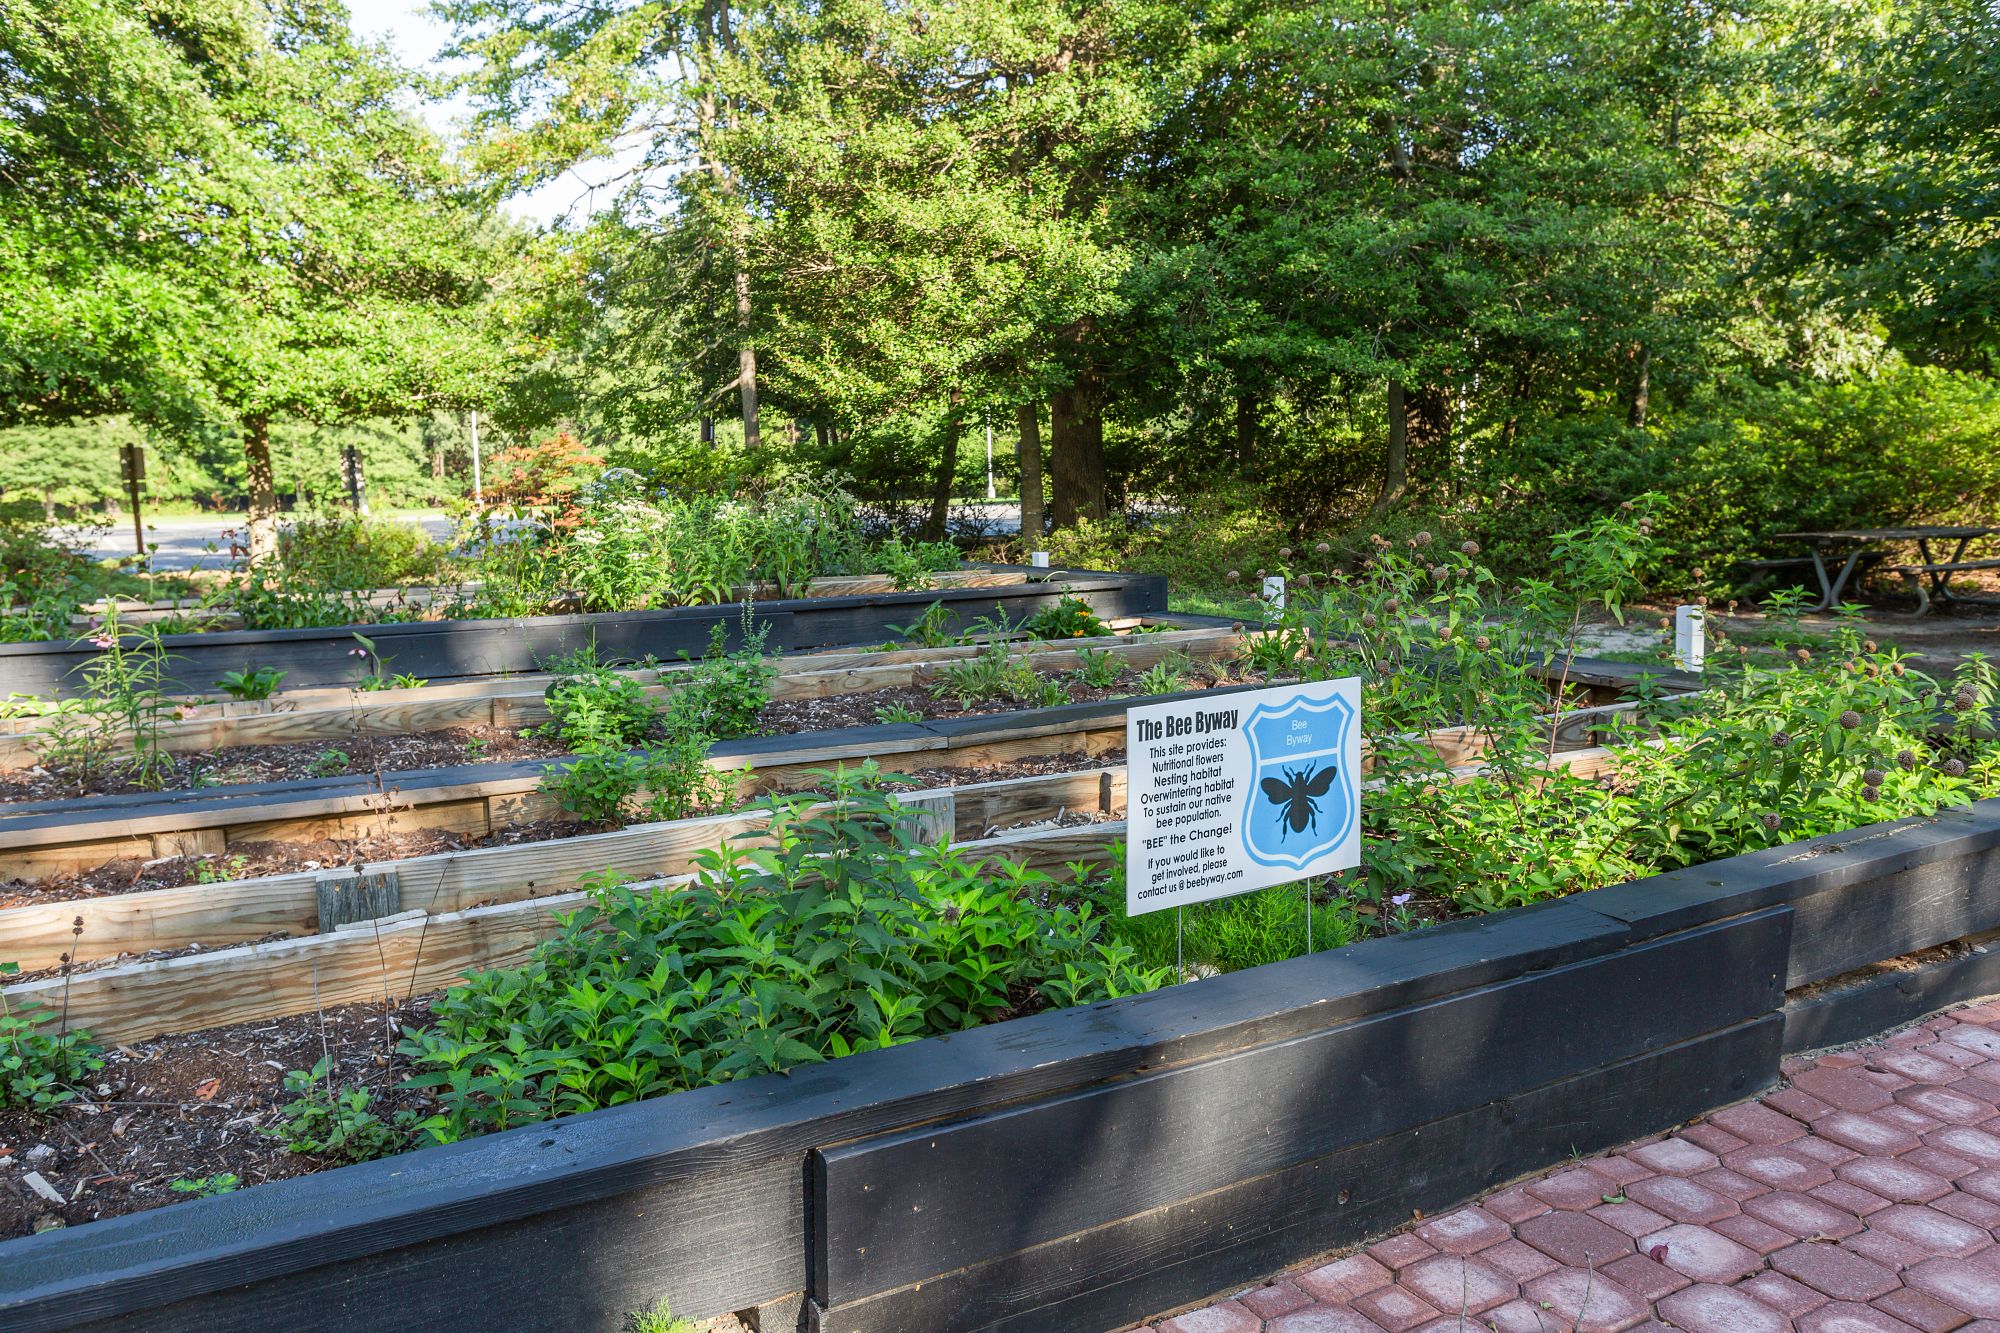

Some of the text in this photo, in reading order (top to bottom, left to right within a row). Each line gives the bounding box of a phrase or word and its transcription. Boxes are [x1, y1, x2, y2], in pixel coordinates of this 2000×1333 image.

[1137, 709, 1238, 742] The Bee Byway
[1292, 719, 1307, 730] Bee
[1150, 738, 1227, 758] This site provides:
[1286, 733, 1312, 746] Byway
[1152, 754, 1223, 773] Nutritional flowers
[1154, 766, 1221, 787] Nesting habitat
[1141, 778, 1234, 804] Overwintering habitat
[1144, 794, 1231, 817] To sustain our native
[1157, 809, 1221, 828] bee population.
[1142, 823, 1232, 849] "BEE" the Change!
[1148, 845, 1224, 870] If you would like to
[1152, 859, 1227, 884] get involved, please
[1138, 869, 1243, 899] contact us @ beebyway.com
